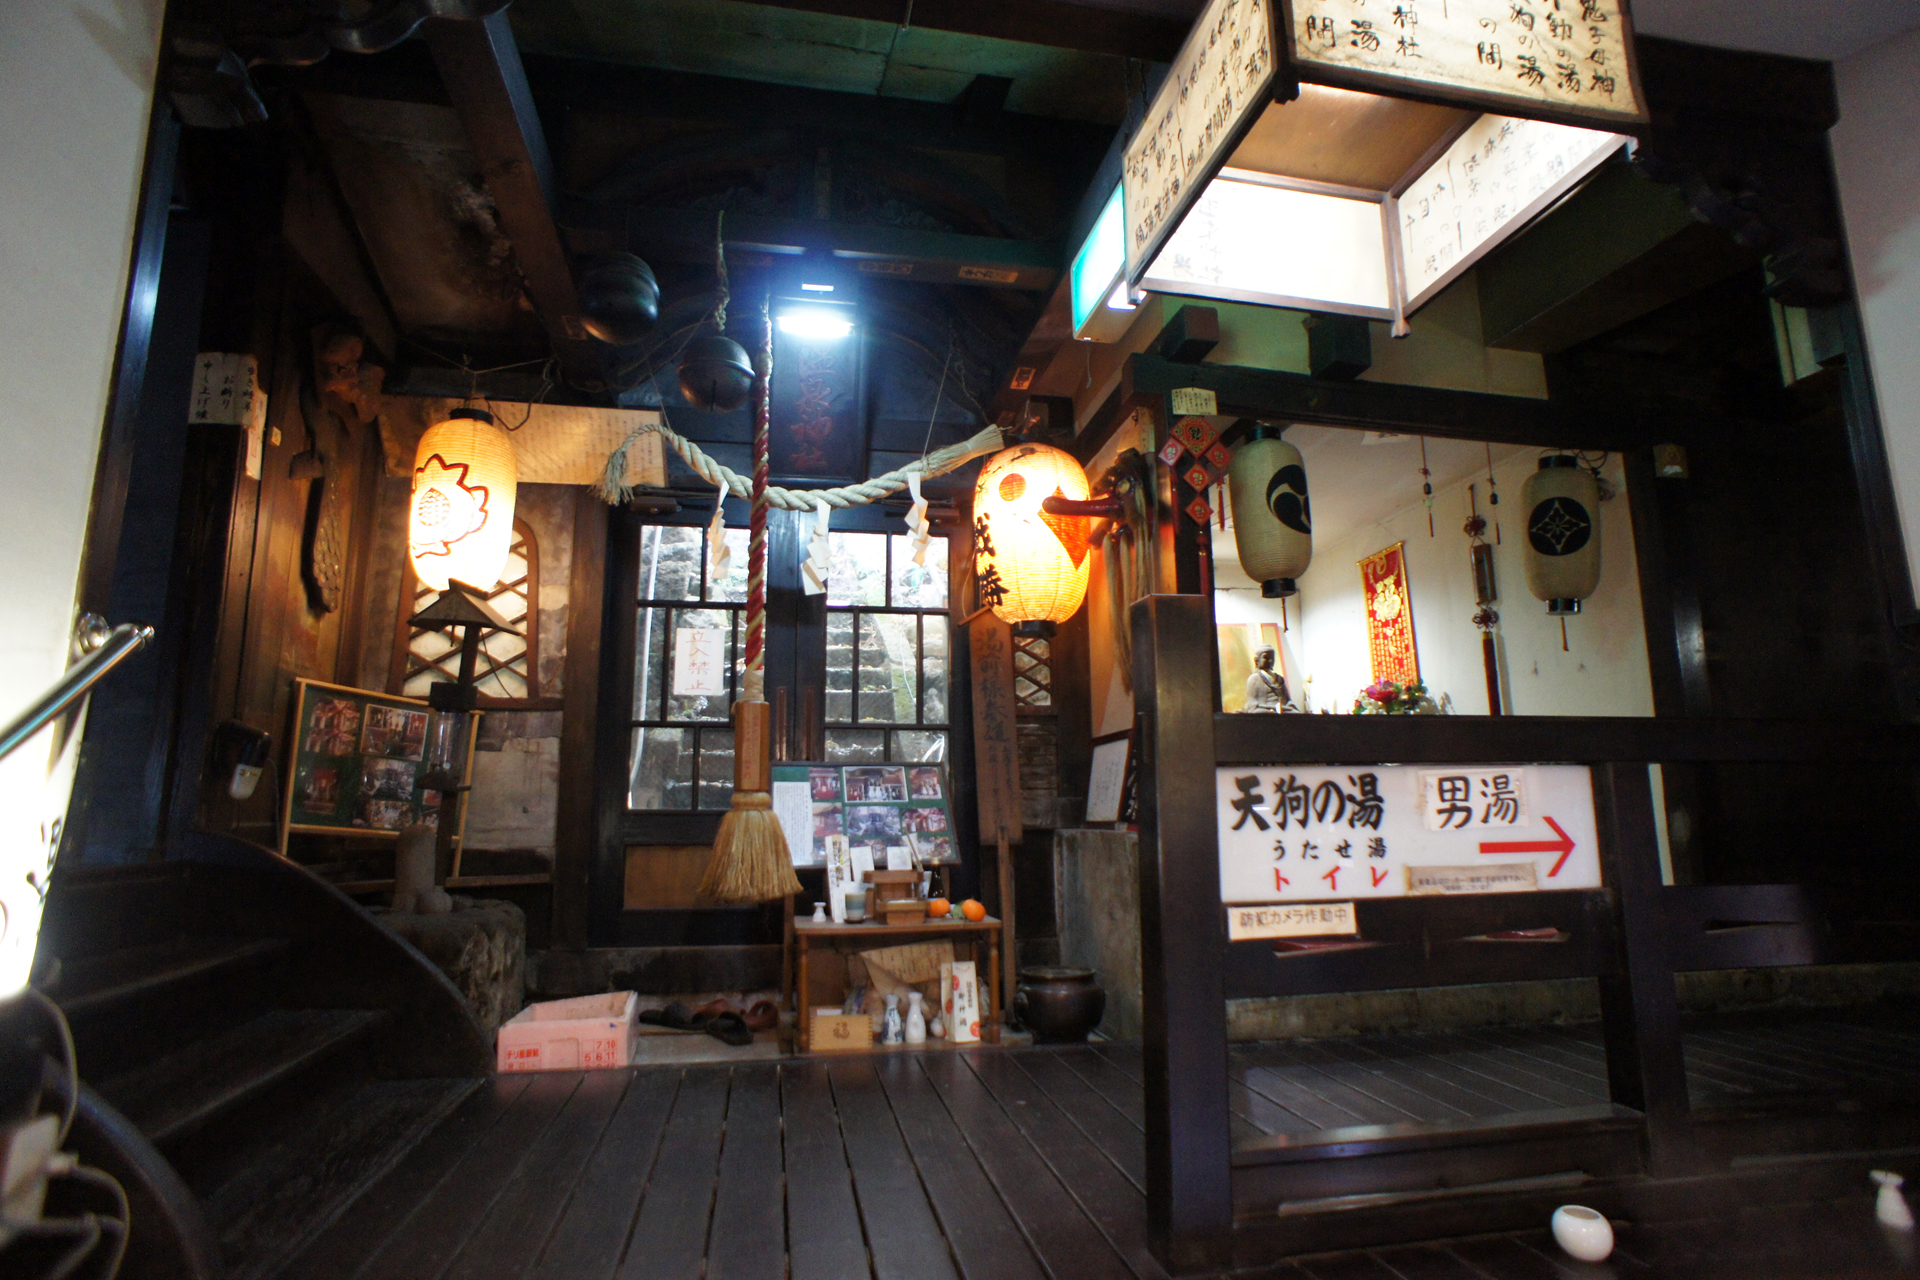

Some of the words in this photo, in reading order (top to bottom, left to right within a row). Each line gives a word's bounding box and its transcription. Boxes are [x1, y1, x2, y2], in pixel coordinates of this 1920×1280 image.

[1392, 0, 1423, 58] 神社
[1478, 18, 1503, 70] の間
[1509, 0, 1546, 87] 狗の湯
[685, 631, 712, 691] 立入禁止
[1229, 772, 1386, 831] 天狗の湯
[1436, 774, 1521, 830] 男湯
[1272, 836, 1387, 861] うたせ湯
[1273, 866, 1389, 893] トイレ
[1239, 907, 1348, 929] 防犯カメラ作動中
[584, 1053, 592, 1062] 5
